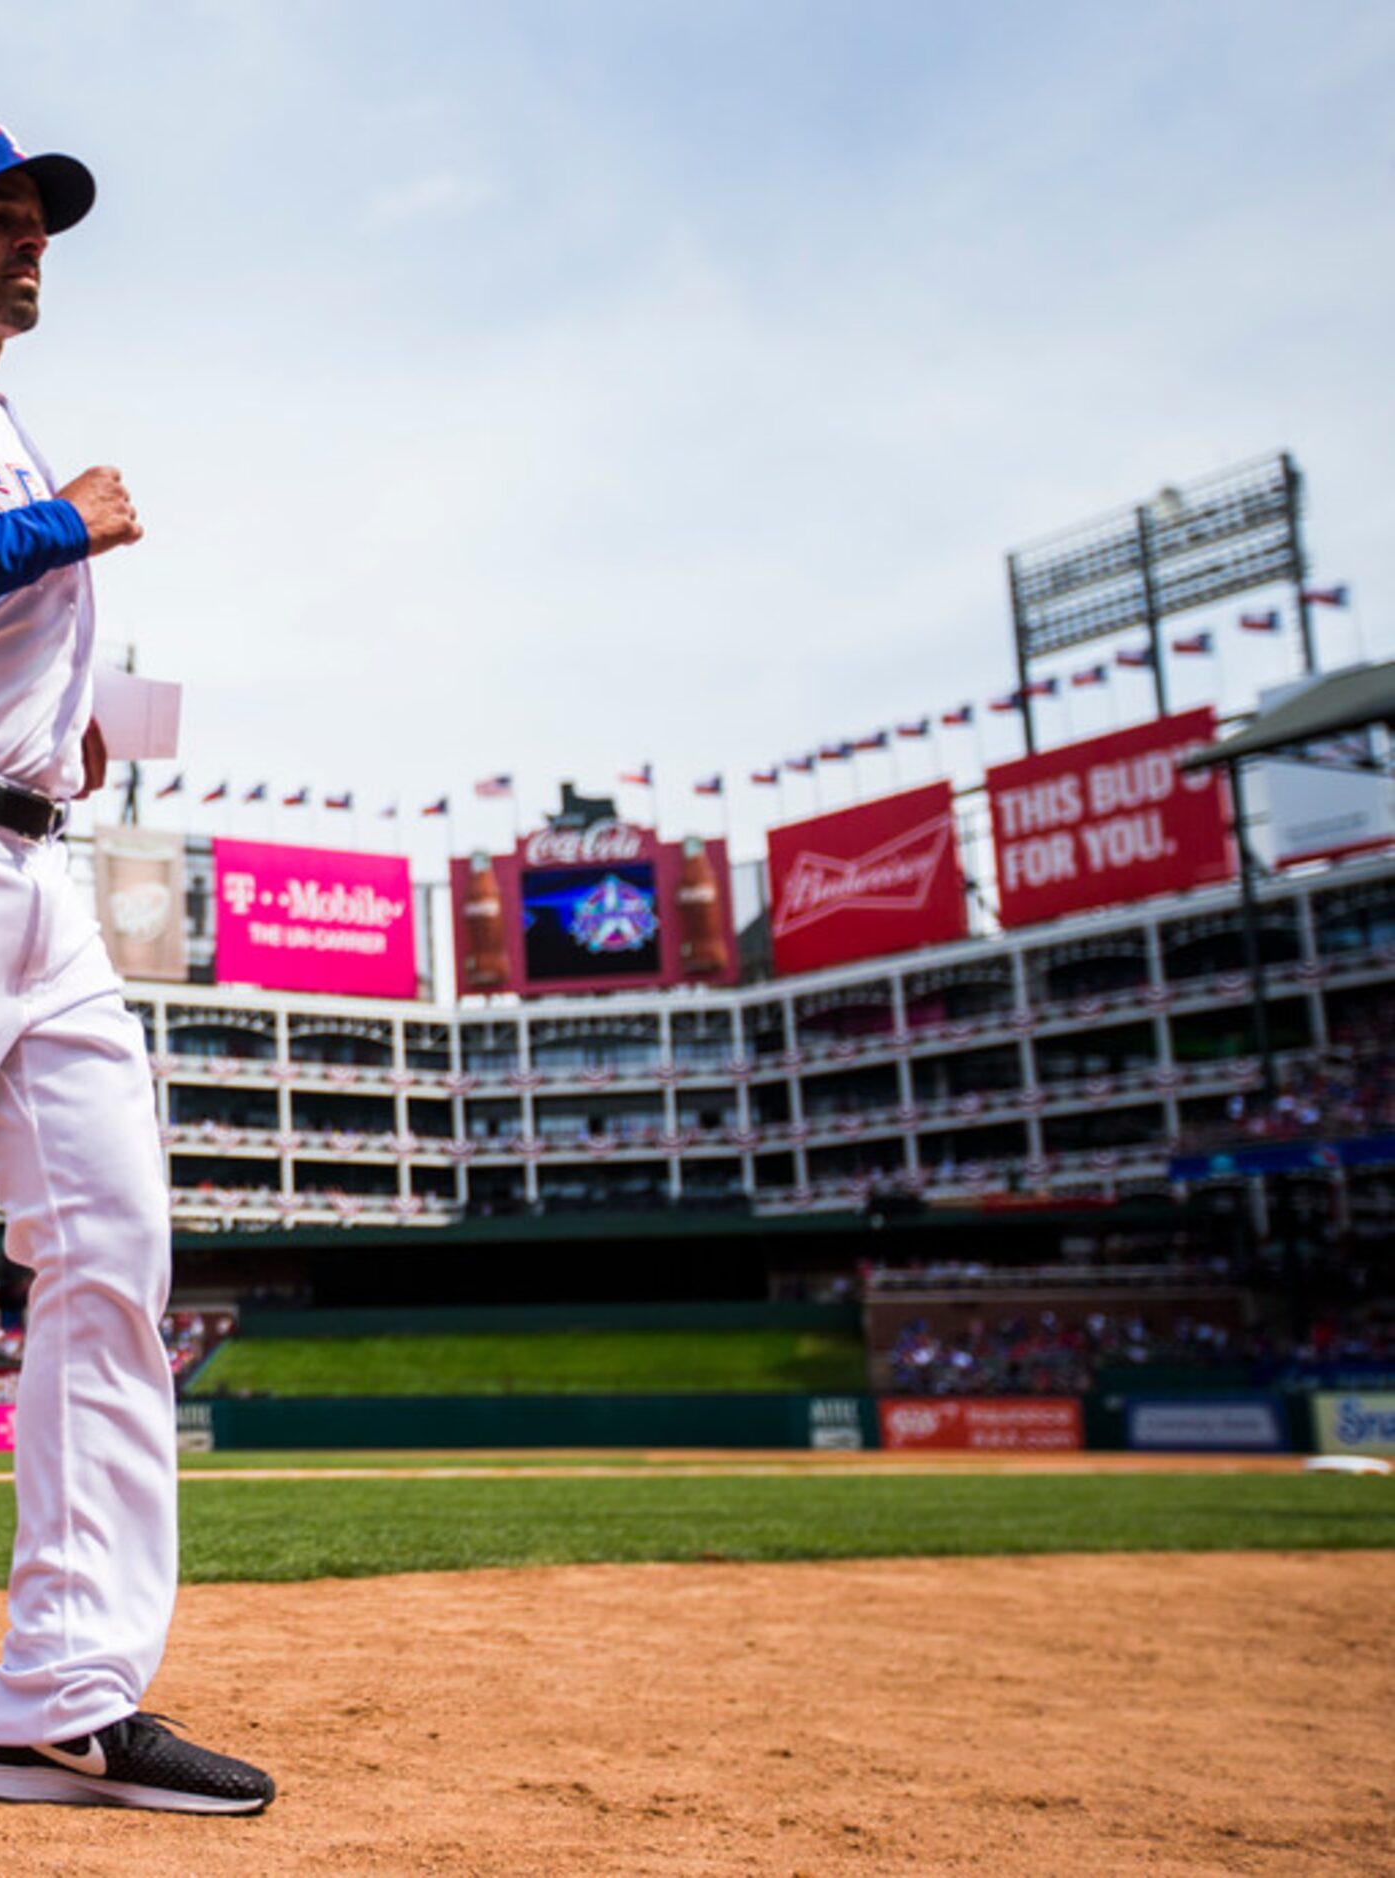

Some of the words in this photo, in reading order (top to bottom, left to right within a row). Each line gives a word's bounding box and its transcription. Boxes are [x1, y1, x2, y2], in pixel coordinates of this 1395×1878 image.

[998, 773, 1083, 837] THIS
[1088, 740, 1213, 815] BUD'S
[1004, 831, 1076, 892] FOR
[1081, 807, 1178, 876] YOU.
[248, 921, 282, 948] THE
